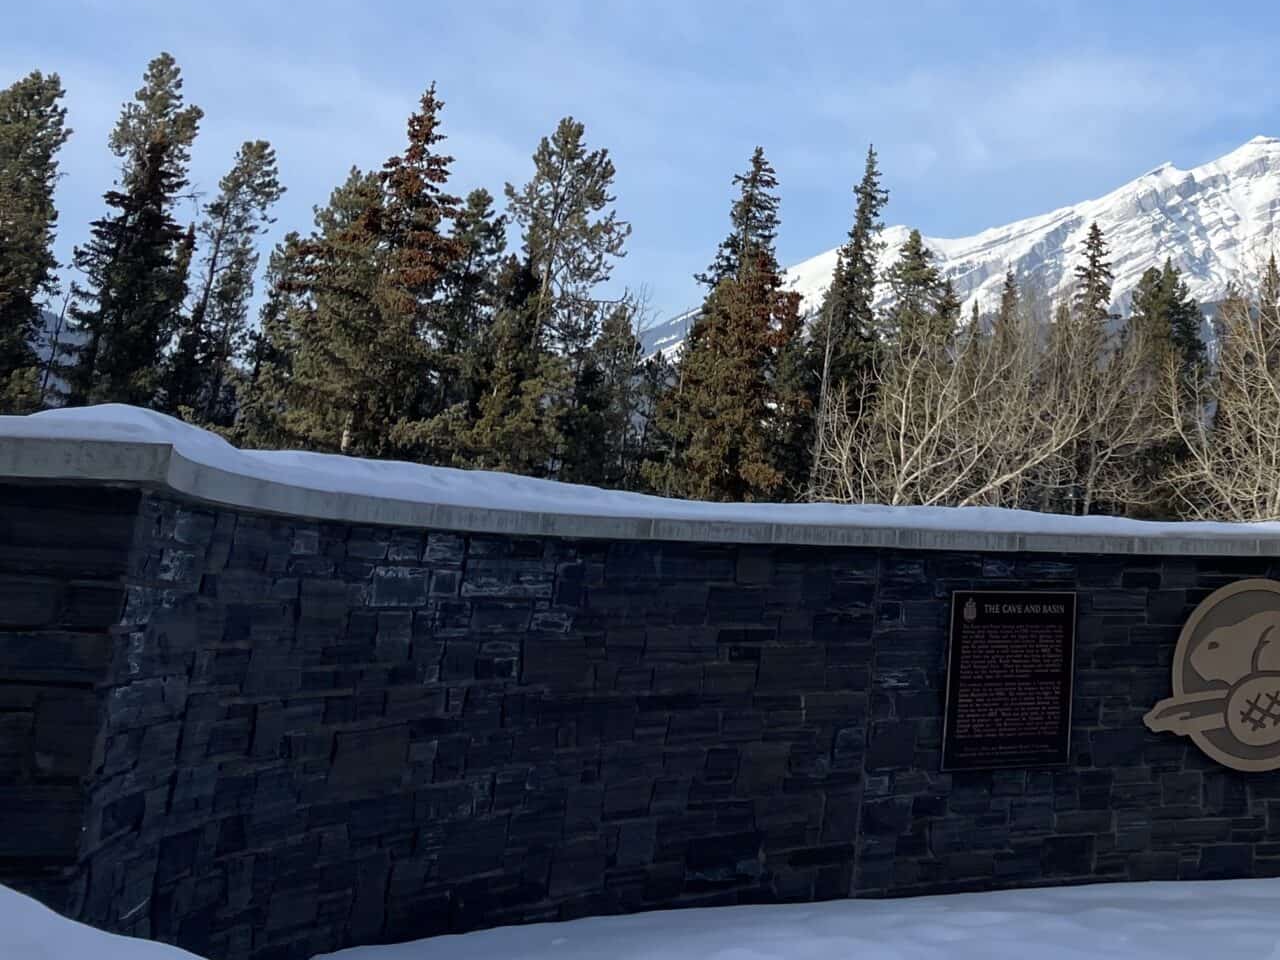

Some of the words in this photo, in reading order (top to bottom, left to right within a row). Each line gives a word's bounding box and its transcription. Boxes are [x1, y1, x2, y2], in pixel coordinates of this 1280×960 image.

[983, 603, 1001, 614] THE
[1002, 603, 1023, 614] CAVE
[1024, 603, 1041, 614] AND
